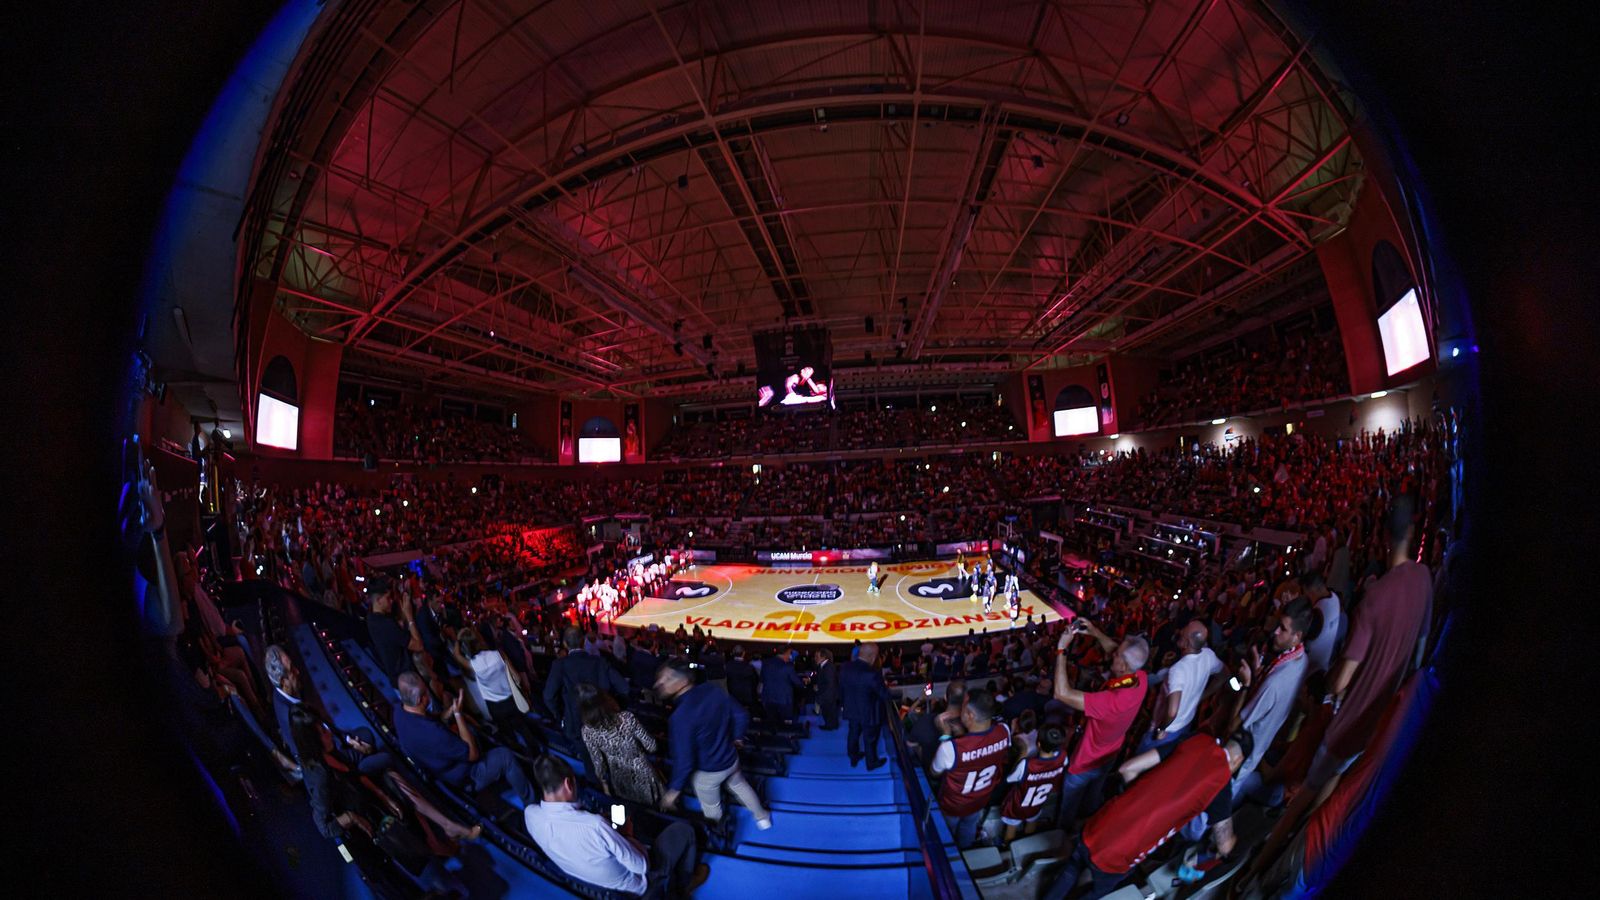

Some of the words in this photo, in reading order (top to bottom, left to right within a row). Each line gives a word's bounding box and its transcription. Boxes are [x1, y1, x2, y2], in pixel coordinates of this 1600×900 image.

[771, 552, 790, 561] UCAM
[791, 551, 813, 561] Murcia
[685, 615, 821, 632] VLADIMIR
[751, 609, 907, 640] 20
[962, 737, 1008, 762] MCFADDEN
[961, 764, 997, 795] 12
[1021, 783, 1053, 807] 12
